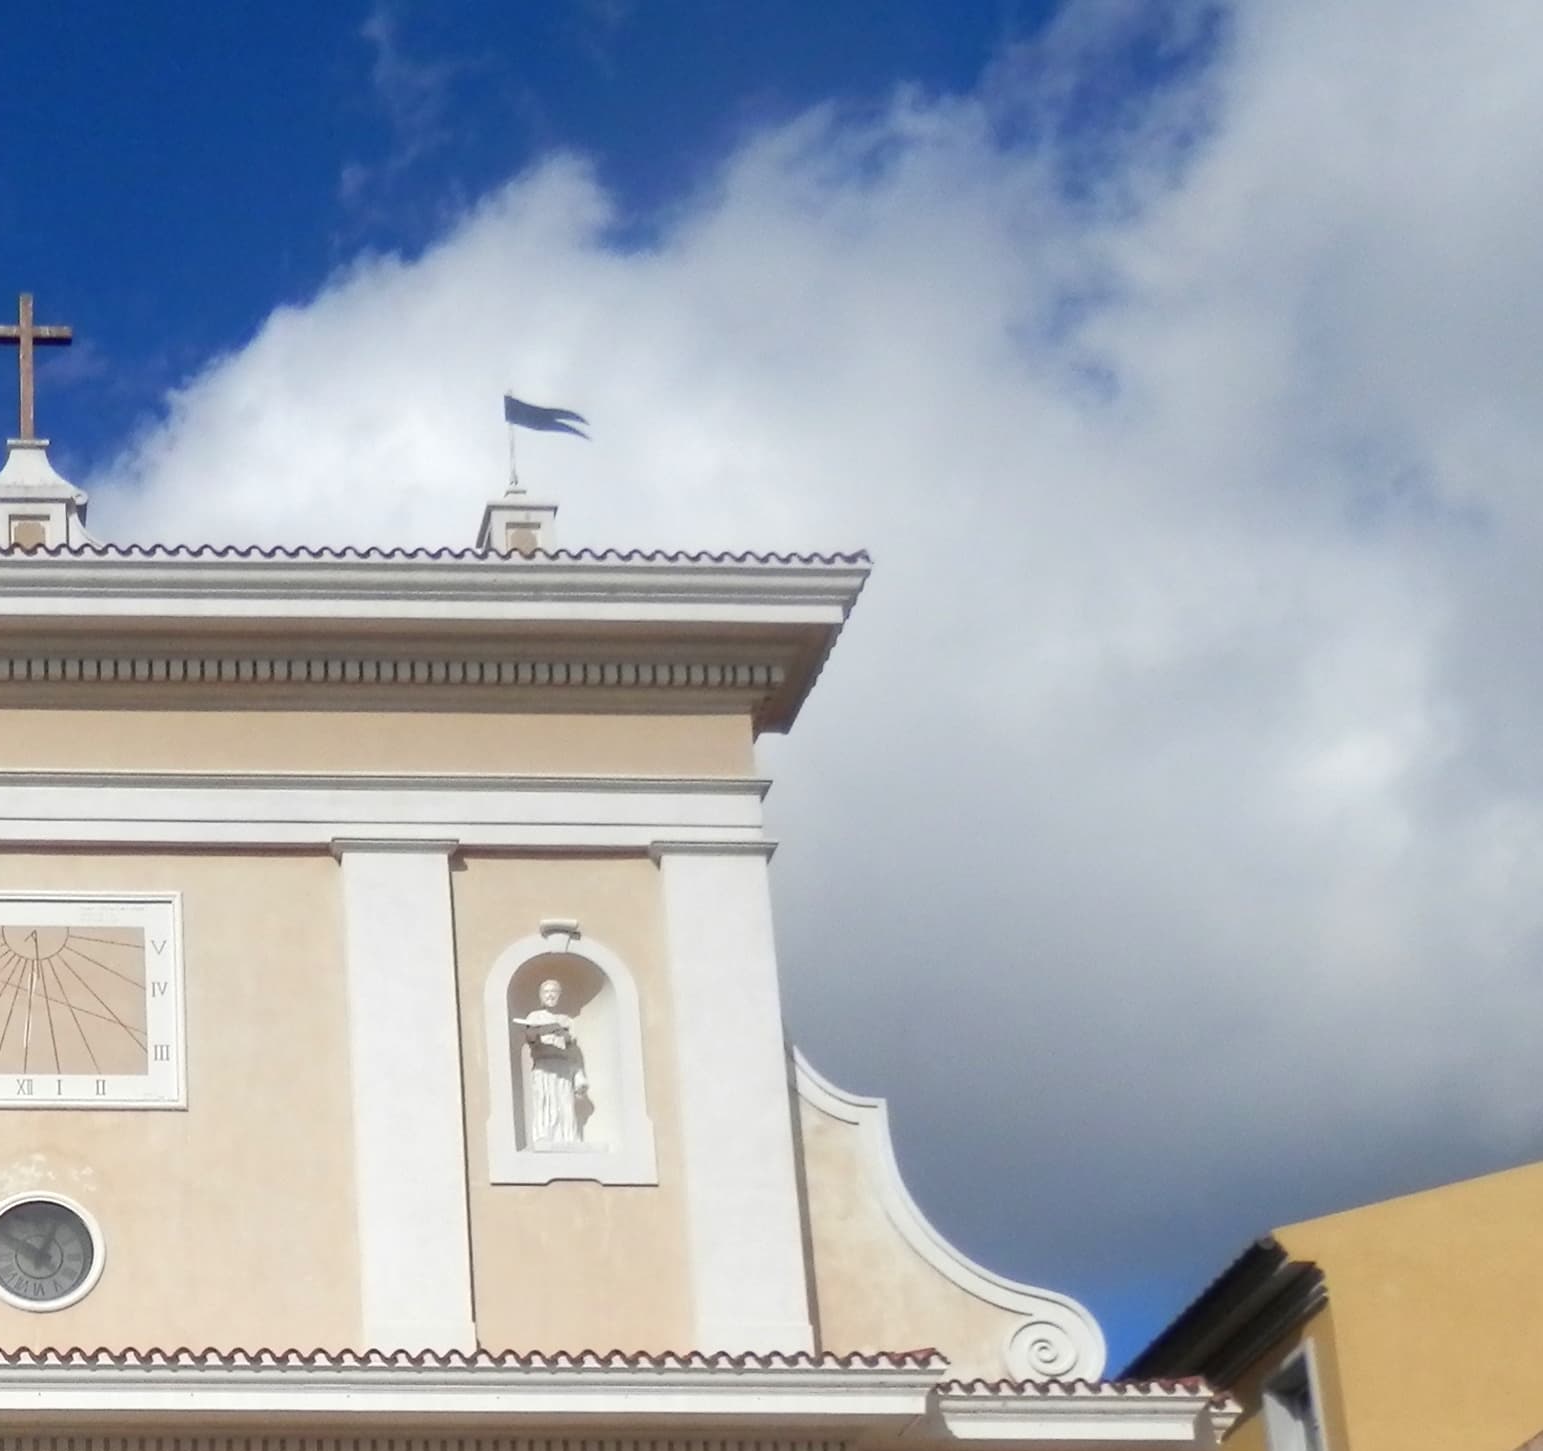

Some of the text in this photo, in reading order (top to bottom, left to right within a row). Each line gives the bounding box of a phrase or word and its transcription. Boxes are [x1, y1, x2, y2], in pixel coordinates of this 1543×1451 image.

[151, 940, 167, 955] V
[152, 982, 168, 998] IV
[154, 1044, 170, 1061] III
[16, 1078, 33, 1095] XII
[96, 1079, 106, 1095] II
